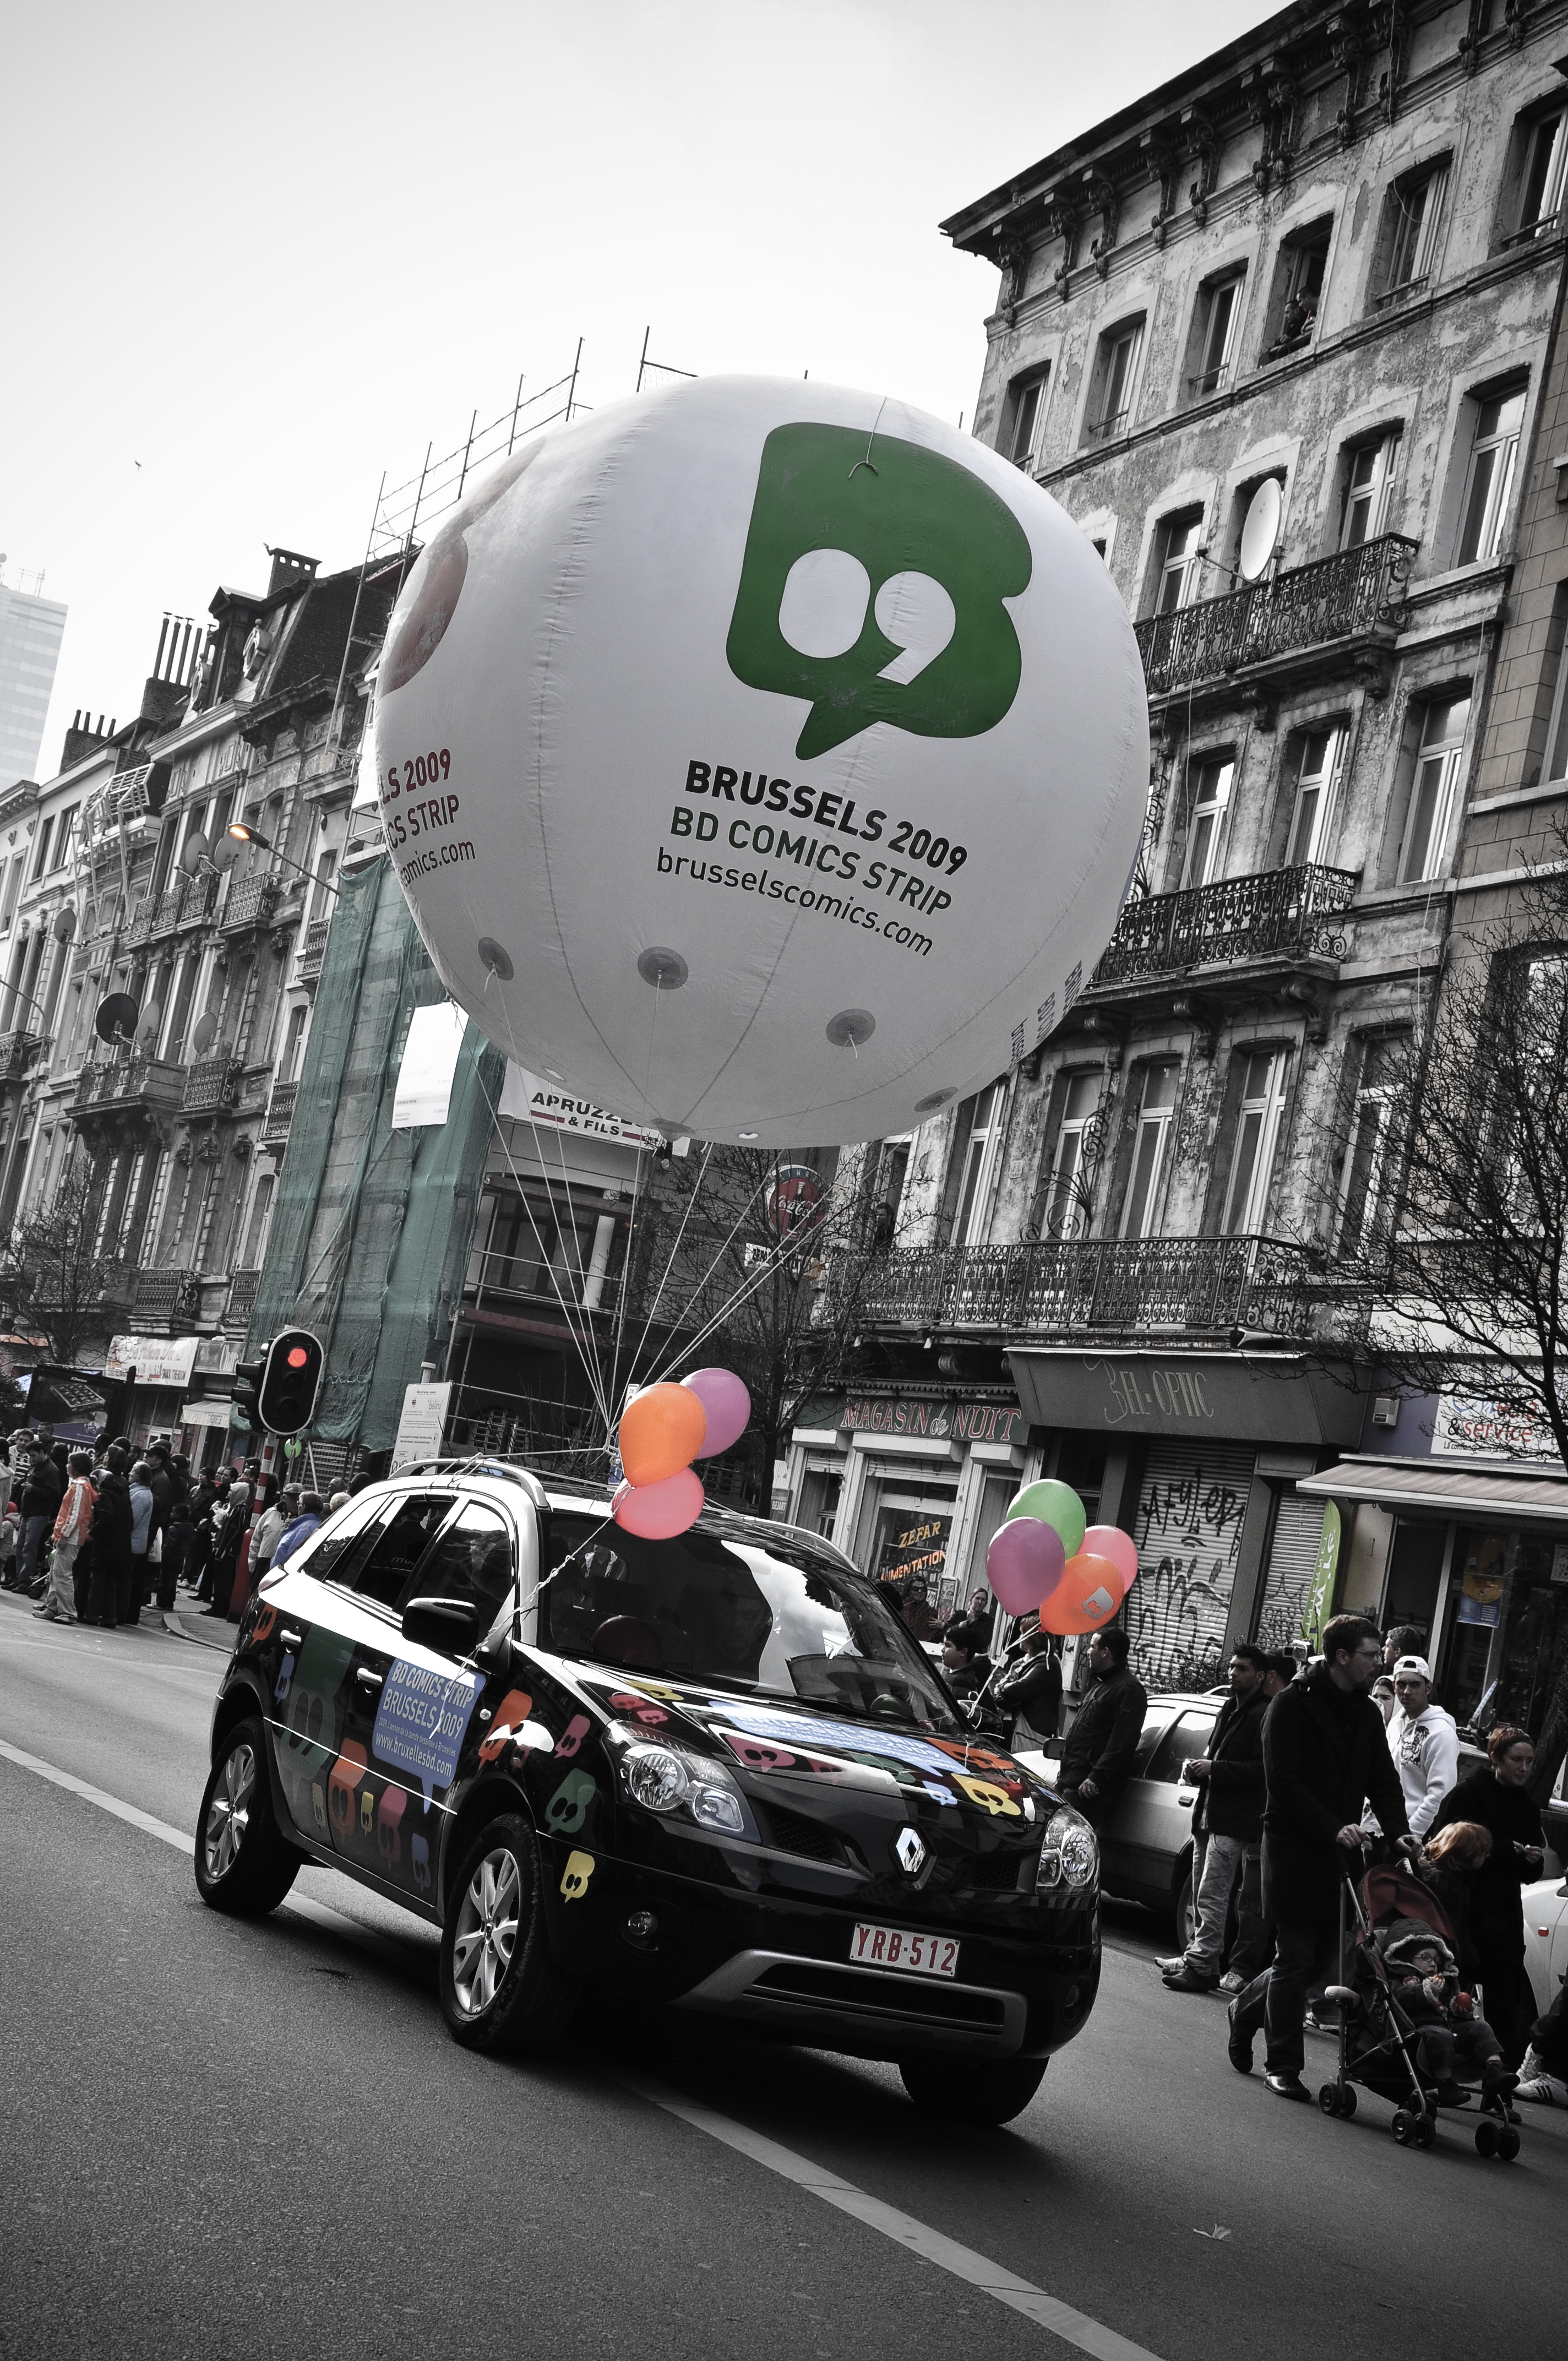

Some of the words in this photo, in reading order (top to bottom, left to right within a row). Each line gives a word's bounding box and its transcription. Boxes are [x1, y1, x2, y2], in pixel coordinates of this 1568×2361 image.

[404, 748, 451, 792] 2009
[407, 794, 459, 836] STRIP
[685, 760, 888, 841] BRUSSELS
[887, 821, 968, 877] 2009
[670, 806, 718, 842] BD
[728, 819, 861, 880] COMICS
[862, 862, 952, 916] STRIP
[657, 846, 933, 956] brusselscomics.com
[568, 1116, 580, 1127] &
[584, 1119, 620, 1135] FILS
[840, 1397, 933, 1434] MAGASIN
[930, 1404, 949, 1436] de
[951, 1405, 1022, 1441] NUIT
[1447, 1418, 1458, 1435] &
[1464, 1422, 1533, 1442] service
[899, 1521, 941, 1548] ZEFAR
[392, 1662, 409, 1684] BD
[406, 1667, 445, 1698] COMICS
[441, 1680, 475, 1708] STRIP
[383, 1688, 437, 1728] BRUSSELS
[437, 1710, 464, 1739] 2009
[375, 1733, 452, 1777] www.bruxellesbd.com
[737, 1716, 876, 1743] BRUSSELS
[880, 1739, 940, 1758] 2009
